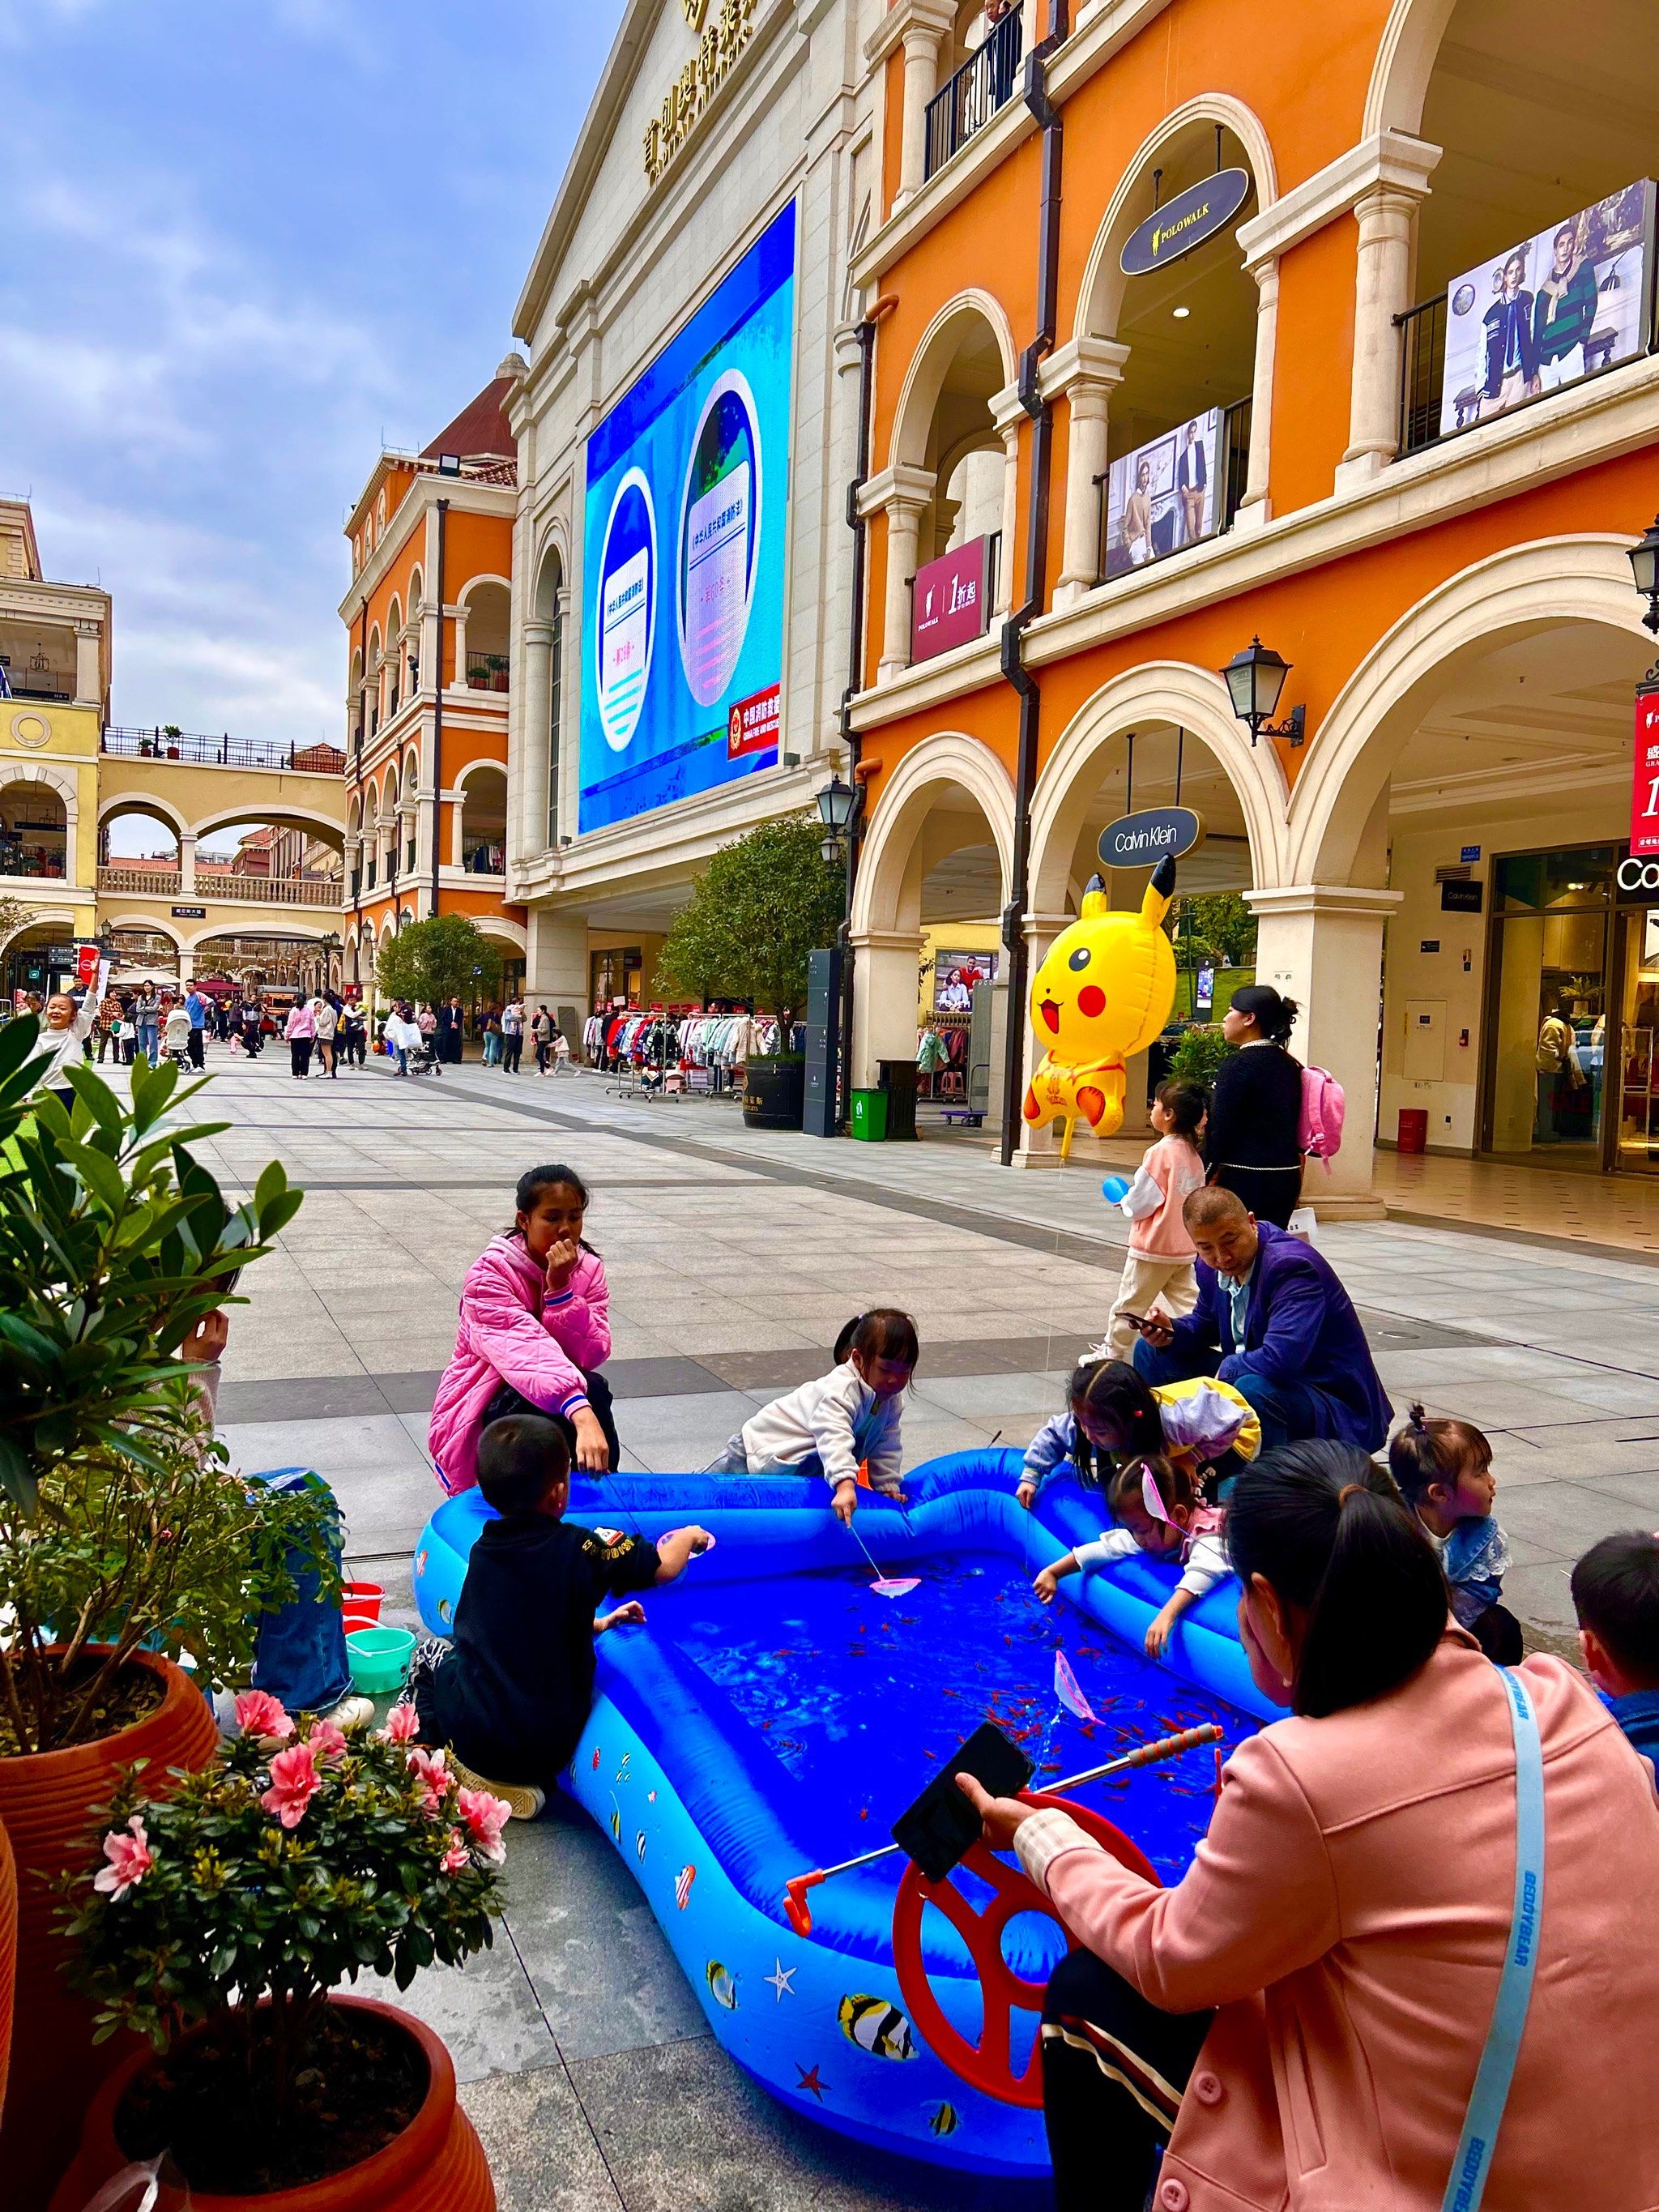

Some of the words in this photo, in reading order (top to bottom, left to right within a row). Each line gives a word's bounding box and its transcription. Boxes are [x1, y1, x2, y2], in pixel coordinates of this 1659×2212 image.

[1161, 203, 1209, 243] POLOWALK
[1115, 829, 1149, 852] Calvin
[1149, 824, 1177, 847] Klein
[1514, 1869, 1537, 1967] BEDDYBEAR
